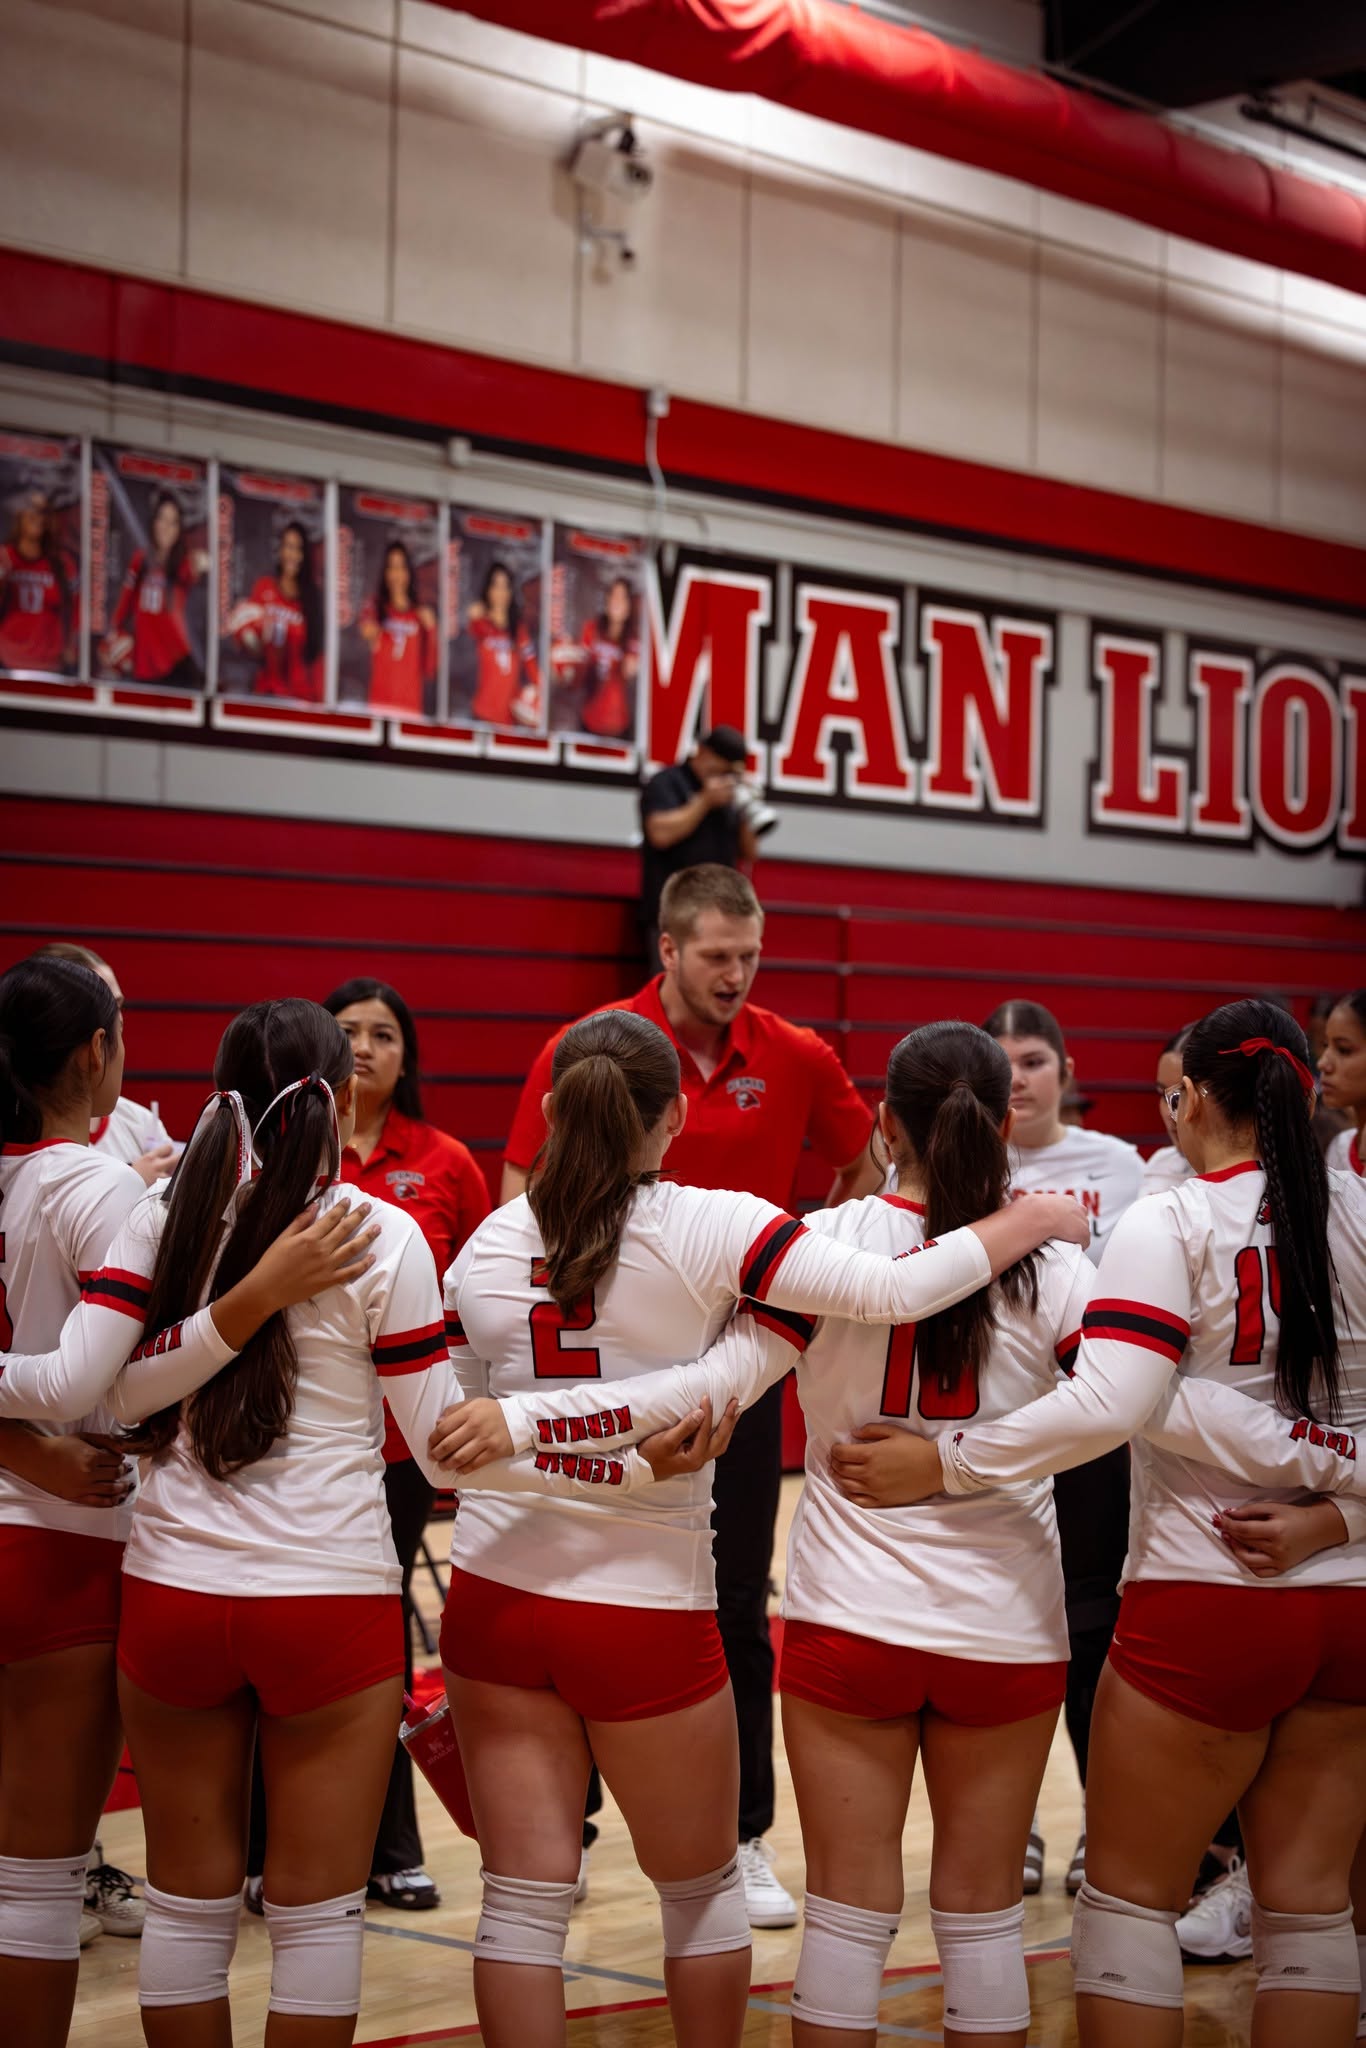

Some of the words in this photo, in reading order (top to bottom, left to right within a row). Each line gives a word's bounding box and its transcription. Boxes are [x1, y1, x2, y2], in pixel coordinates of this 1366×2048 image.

[1093, 632, 1366, 851] LIO
[528, 1257, 602, 1379] 2
[536, 1405, 634, 1444] KERMAN
